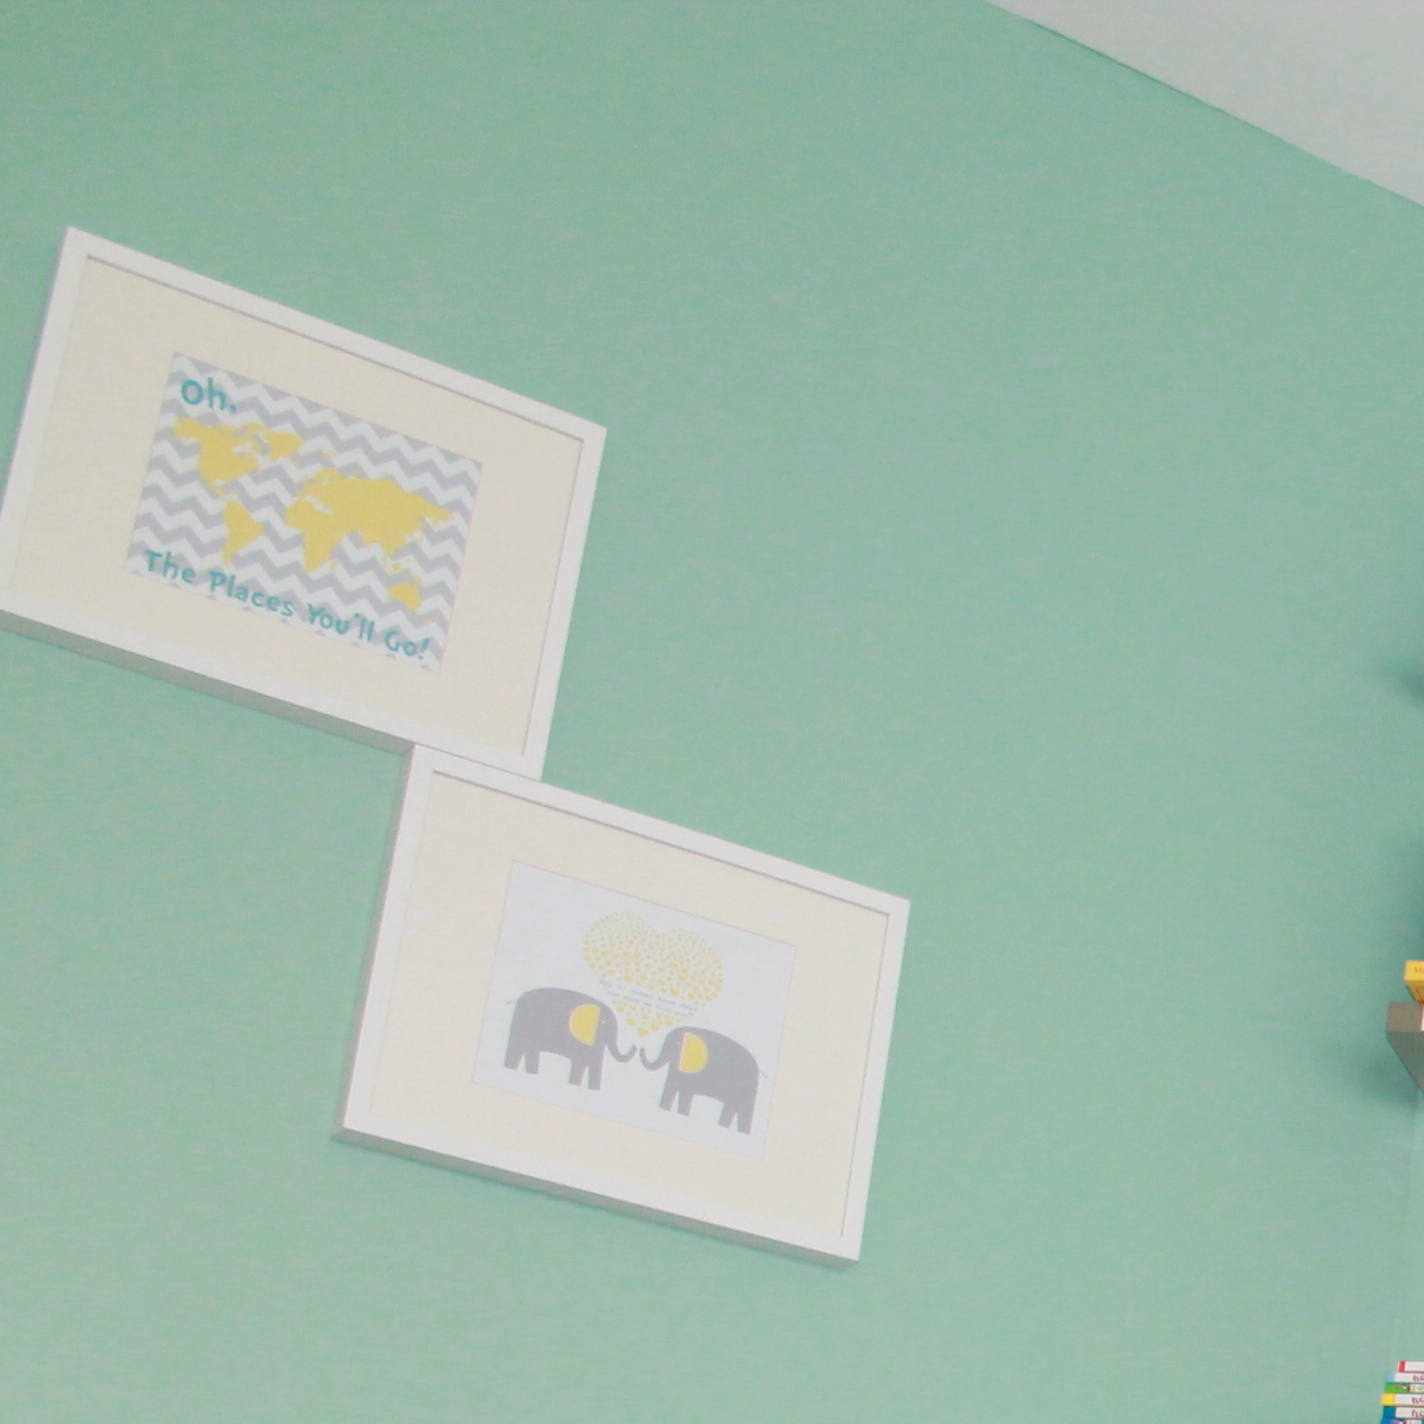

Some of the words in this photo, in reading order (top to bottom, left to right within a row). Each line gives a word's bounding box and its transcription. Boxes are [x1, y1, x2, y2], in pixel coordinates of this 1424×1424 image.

[181, 377, 237, 413] Oh,
[145, 549, 196, 583] The
[208, 570, 294, 617] Places
[306, 604, 377, 643] You'll
[384, 629, 430, 660] Go!
